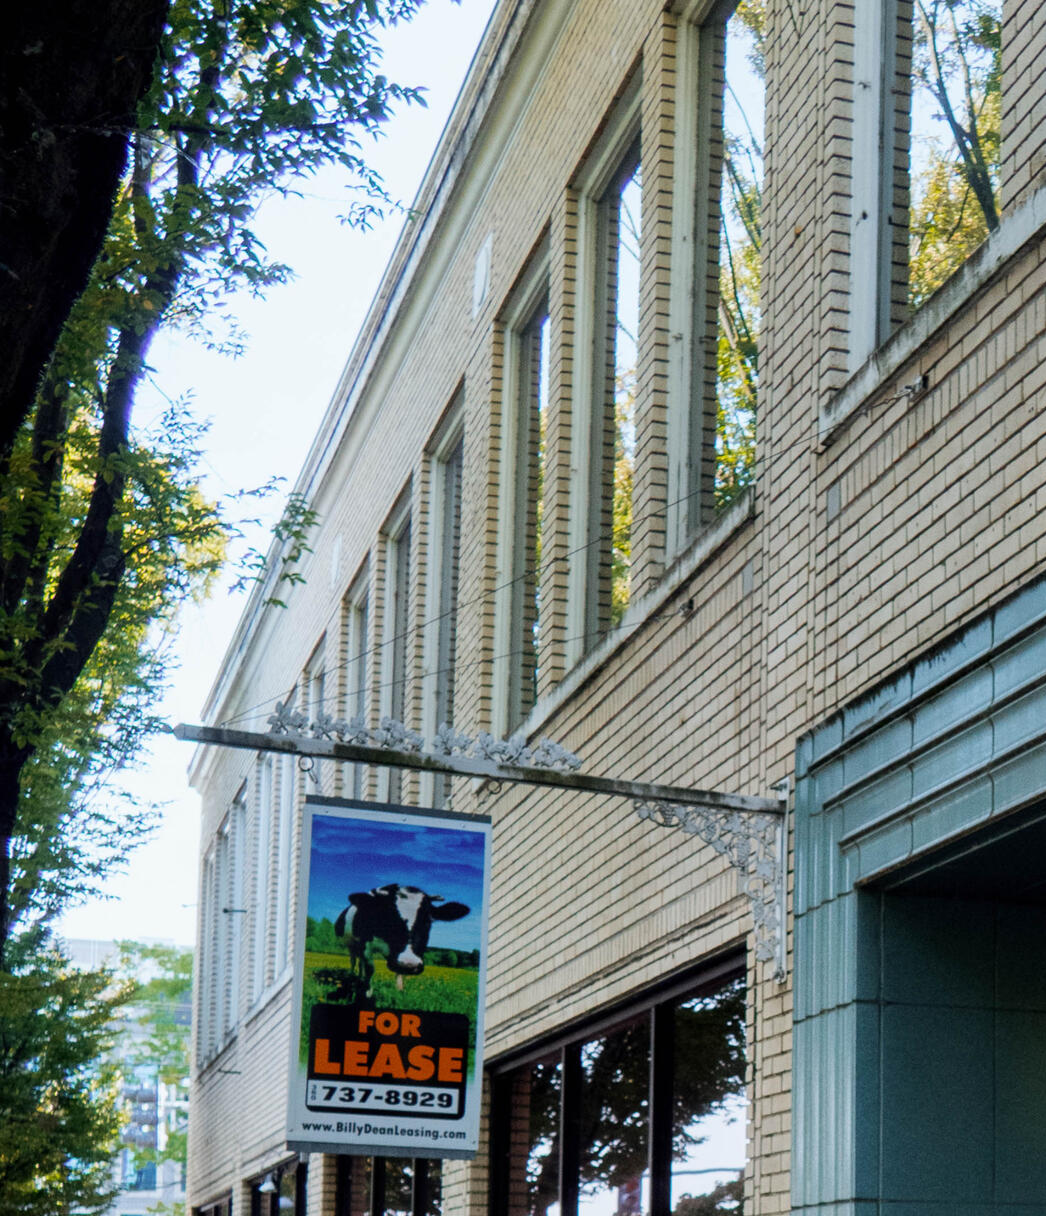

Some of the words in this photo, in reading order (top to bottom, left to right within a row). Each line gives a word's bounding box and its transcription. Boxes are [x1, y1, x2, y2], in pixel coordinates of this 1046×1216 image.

[358, 1010, 422, 1038] FOR
[313, 1038, 464, 1083] LEASE
[321, 1085, 454, 1109] 737-8929
[301, 1121, 467, 1141] www.BillyDeanLeasing.com
